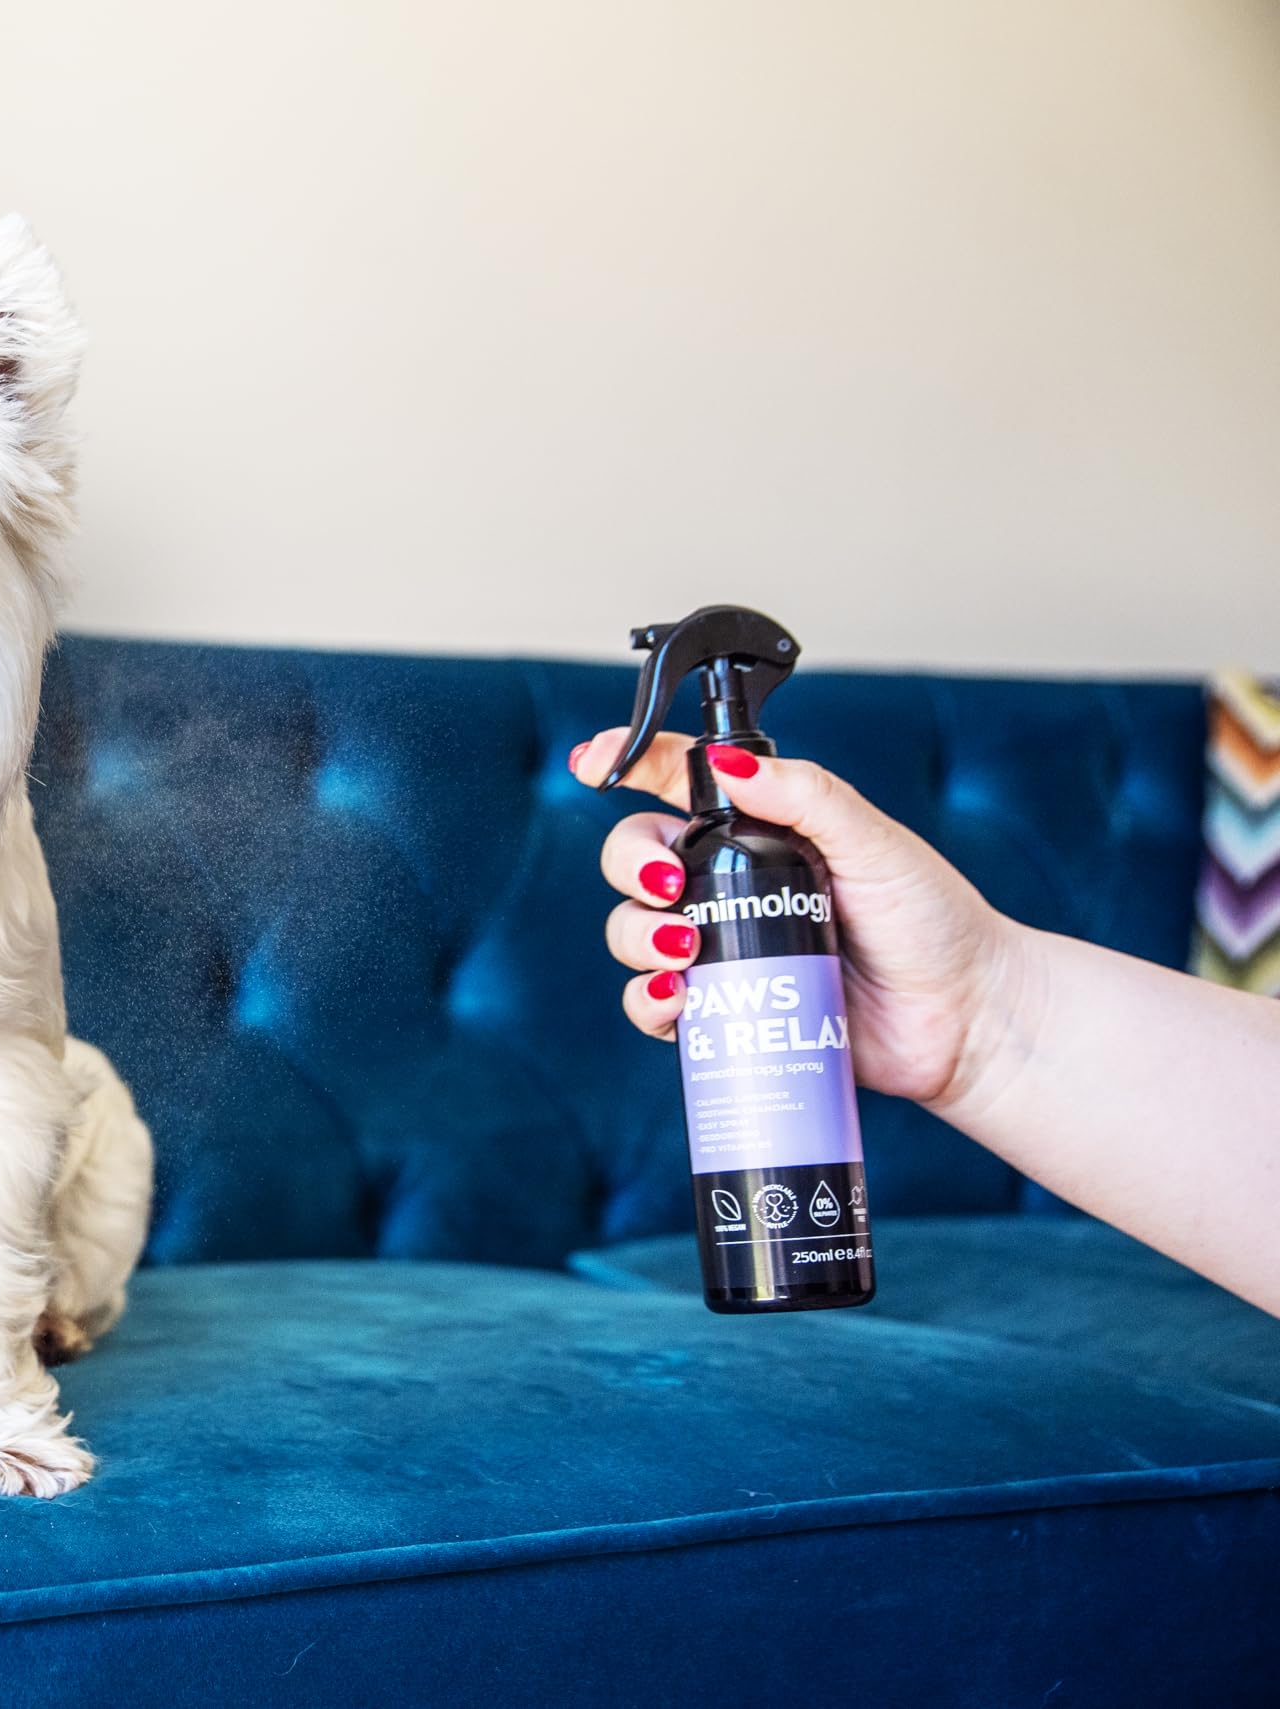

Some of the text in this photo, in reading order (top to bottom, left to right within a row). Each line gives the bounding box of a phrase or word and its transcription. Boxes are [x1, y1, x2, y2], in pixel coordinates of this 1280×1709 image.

[683, 886, 832, 925] animology
[684, 975, 801, 1021] PAWS
[687, 1015, 849, 1062] & RELAX
[690, 1061, 824, 1082] Aromathapy spray
[816, 1197, 834, 1210] 0%
[791, 1249, 834, 1264] 250ml
